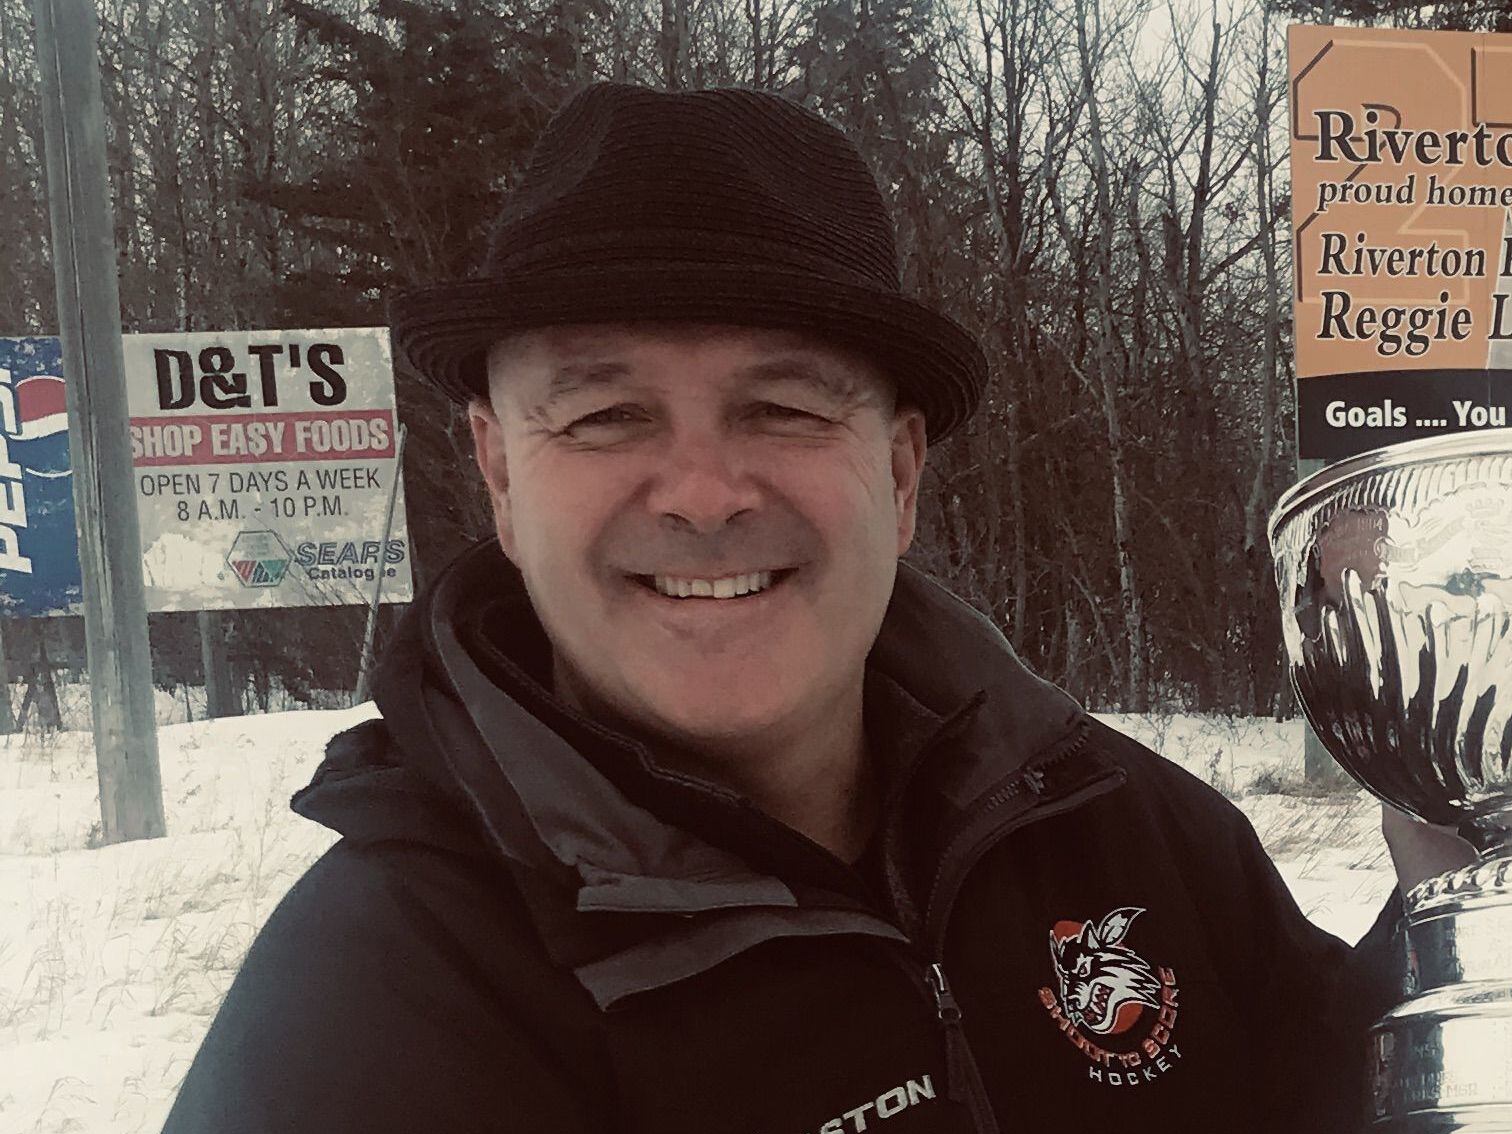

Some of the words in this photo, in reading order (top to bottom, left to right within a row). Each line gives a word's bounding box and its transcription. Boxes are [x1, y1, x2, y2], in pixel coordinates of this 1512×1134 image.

[1317, 175, 1415, 211] proud
[1316, 232, 1486, 278] Riverton
[1316, 290, 1474, 358] Reggie
[154, 343, 347, 410] D&T'S
[1325, 400, 1407, 428] Goals
[1453, 401, 1504, 428] You
[130, 423, 203, 460] SHOP
[211, 420, 285, 457] EASY
[295, 417, 390, 453] FOODS
[0, 368, 33, 574] PEP
[140, 474, 200, 496] OPEN
[210, 472, 224, 494] 7
[230, 471, 289, 493] DAYS
[297, 470, 312, 490] A
[317, 467, 382, 489] WEEK
[177, 498, 190, 521] 8
[198, 497, 246, 520] A.M.
[273, 497, 297, 518] 10
[304, 496, 349, 517] P.M.
[295, 540, 406, 566] SEARS
[309, 567, 396, 581] Cataloge
[1089, 1044, 1182, 1086] HOCKEY
